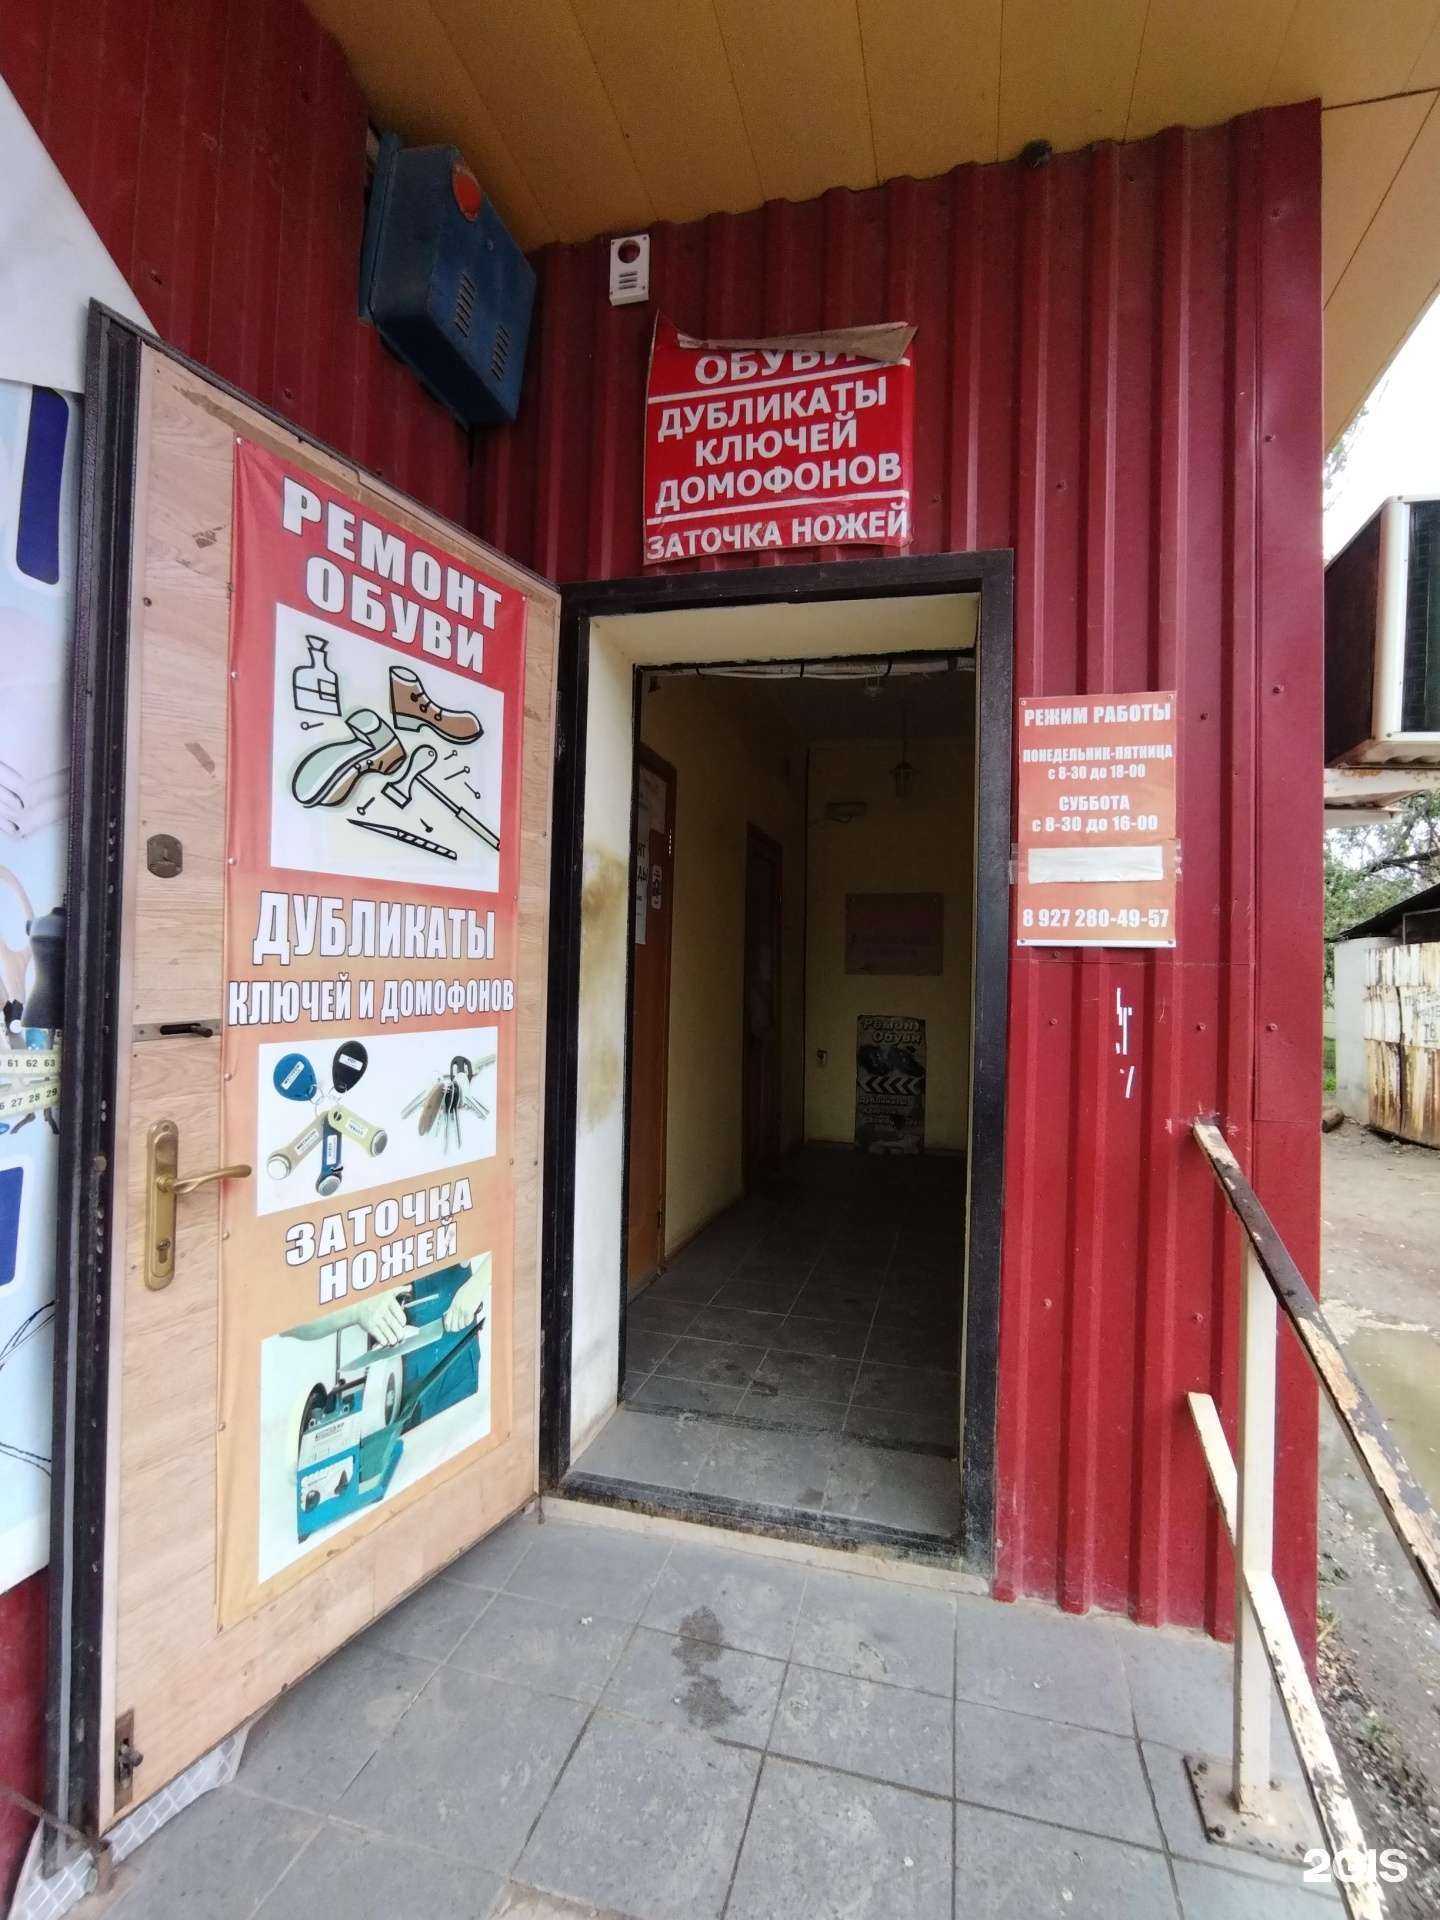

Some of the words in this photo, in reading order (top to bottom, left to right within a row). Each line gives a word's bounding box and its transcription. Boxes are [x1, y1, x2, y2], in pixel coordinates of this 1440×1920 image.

[657, 376, 887, 443] ДУБЛИКАТЫ
[695, 411, 857, 467] КЛЮЧЕЙ
[655, 452, 902, 515] ДОМОФОНОВ
[282, 475, 502, 630] РЕМОНТ
[646, 520, 783, 560] ЗАТОЧКА
[791, 501, 908, 545] НОЖЕЙ
[306, 556, 484, 674] ОБУВИ
[1024, 706, 1088, 727] РЕЖИМ
[1093, 703, 1171, 724] РАБОТЫ
[1022, 743, 1173, 765] ПОНЕДЕЛЬНИК-ПЯТНИЦА
[1047, 768, 1056, 780] с
[1058, 765, 1087, 780] 8-30
[1090, 767, 1107, 782] до
[1110, 763, 1146, 779] 18-00
[1032, 818, 1041, 832] с
[1045, 815, 1082, 832] 8-30
[1085, 816, 1108, 834] до
[1112, 814, 1159, 831] 16-00
[1058, 794, 1130, 812] СУББОТА
[252, 890, 496, 966] ДУБЛИКАТЫ
[1023, 908, 1034, 927] 8
[1038, 908, 1071, 928] 927
[1074, 908, 1170, 928] 280-49-57
[227, 972, 352, 1026] КЛЮЧЕЙ
[358, 979, 375, 1019] И
[380, 978, 516, 1024] ДОМОФОНОВ
[26, 1058, 38, 1068] 62
[44, 1058, 56, 1068] 63
[11, 1097, 23, 1108] 27
[46, 1087, 58, 1099] 29
[285, 1176, 474, 1267] ЗАТОЧКА
[318, 1214, 458, 1305] НОЖЕЙ
